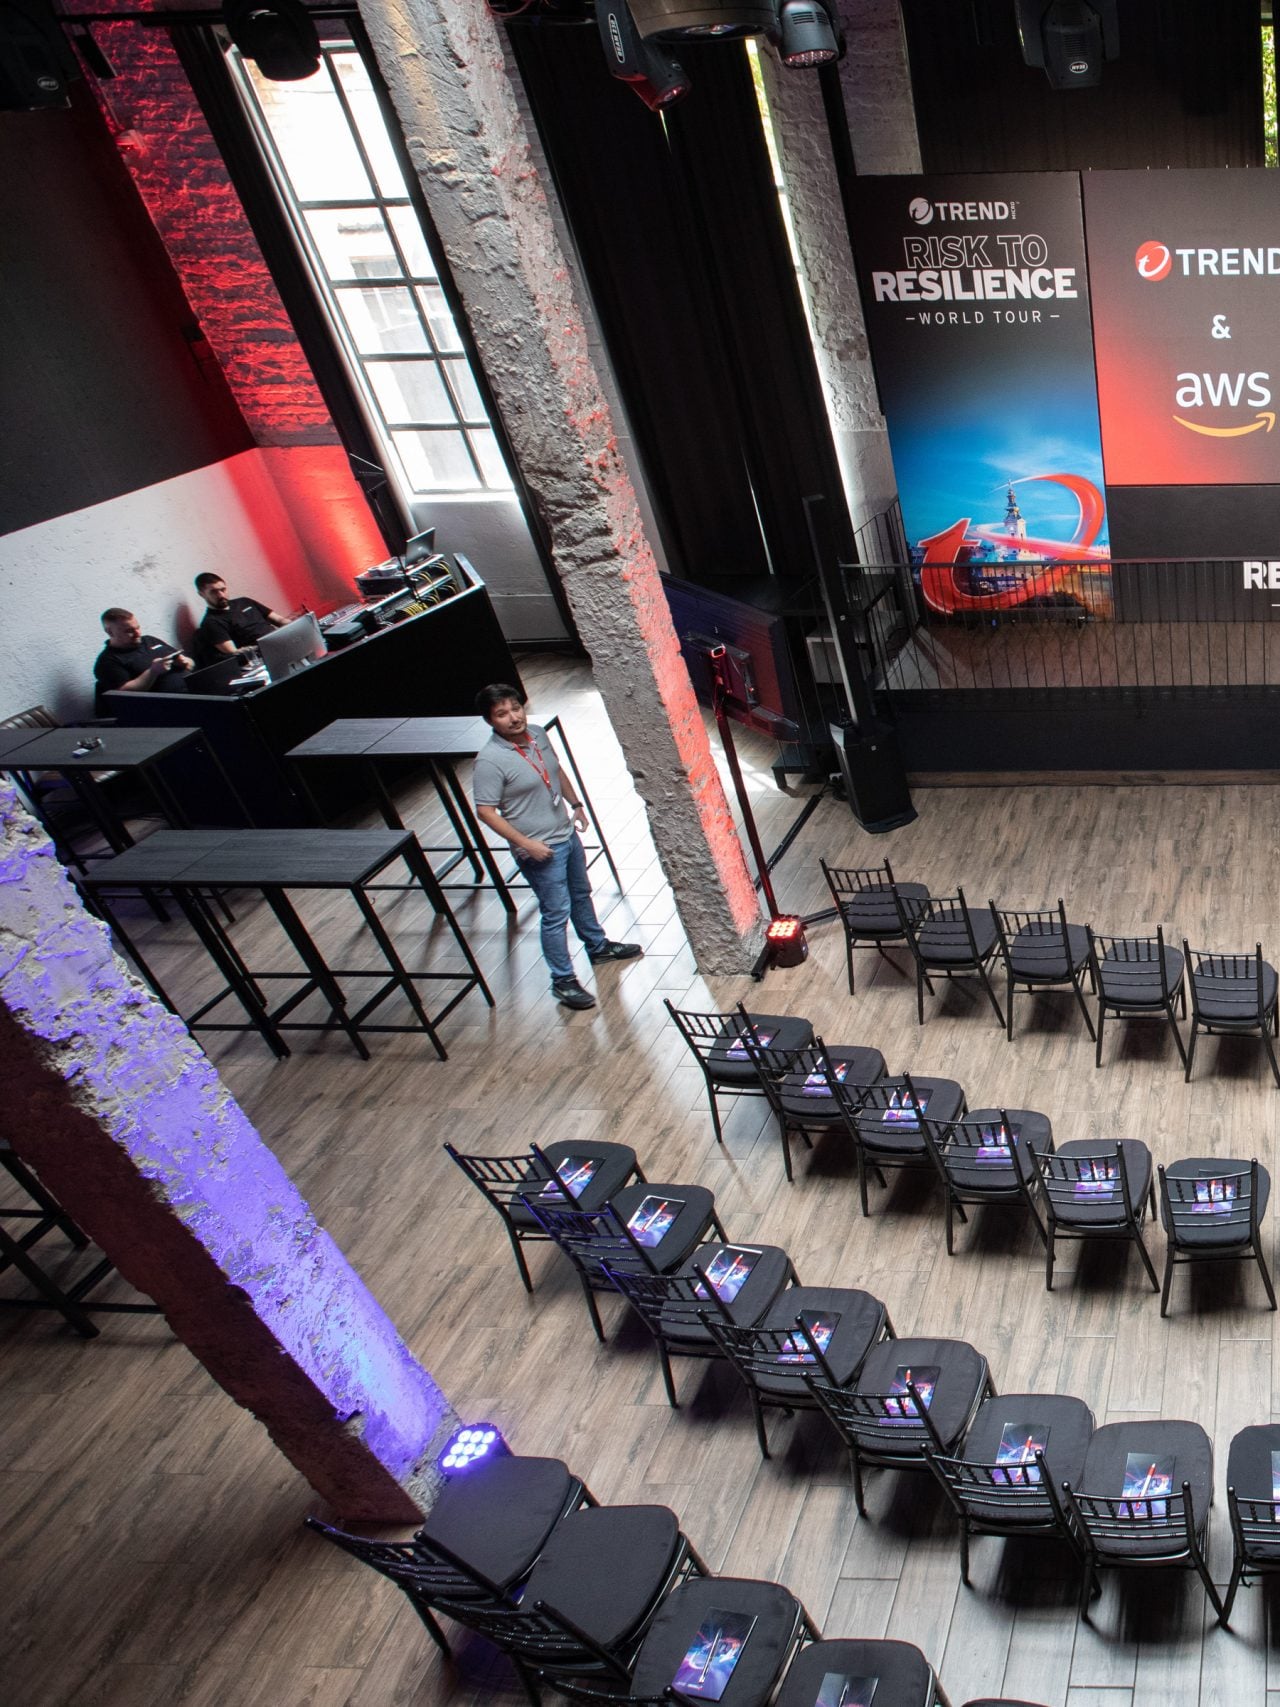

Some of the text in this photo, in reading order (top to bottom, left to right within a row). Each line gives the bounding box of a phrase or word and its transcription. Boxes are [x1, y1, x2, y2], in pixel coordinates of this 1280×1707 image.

[935, 202, 1009, 220] TREND
[903, 234, 1048, 269] RISK TO
[873, 268, 1078, 302] RESILIENCE
[918, 310, 1042, 325] WORLD TOUR
[1211, 314, 1232, 340] &
[1176, 372, 1271, 408] aws
